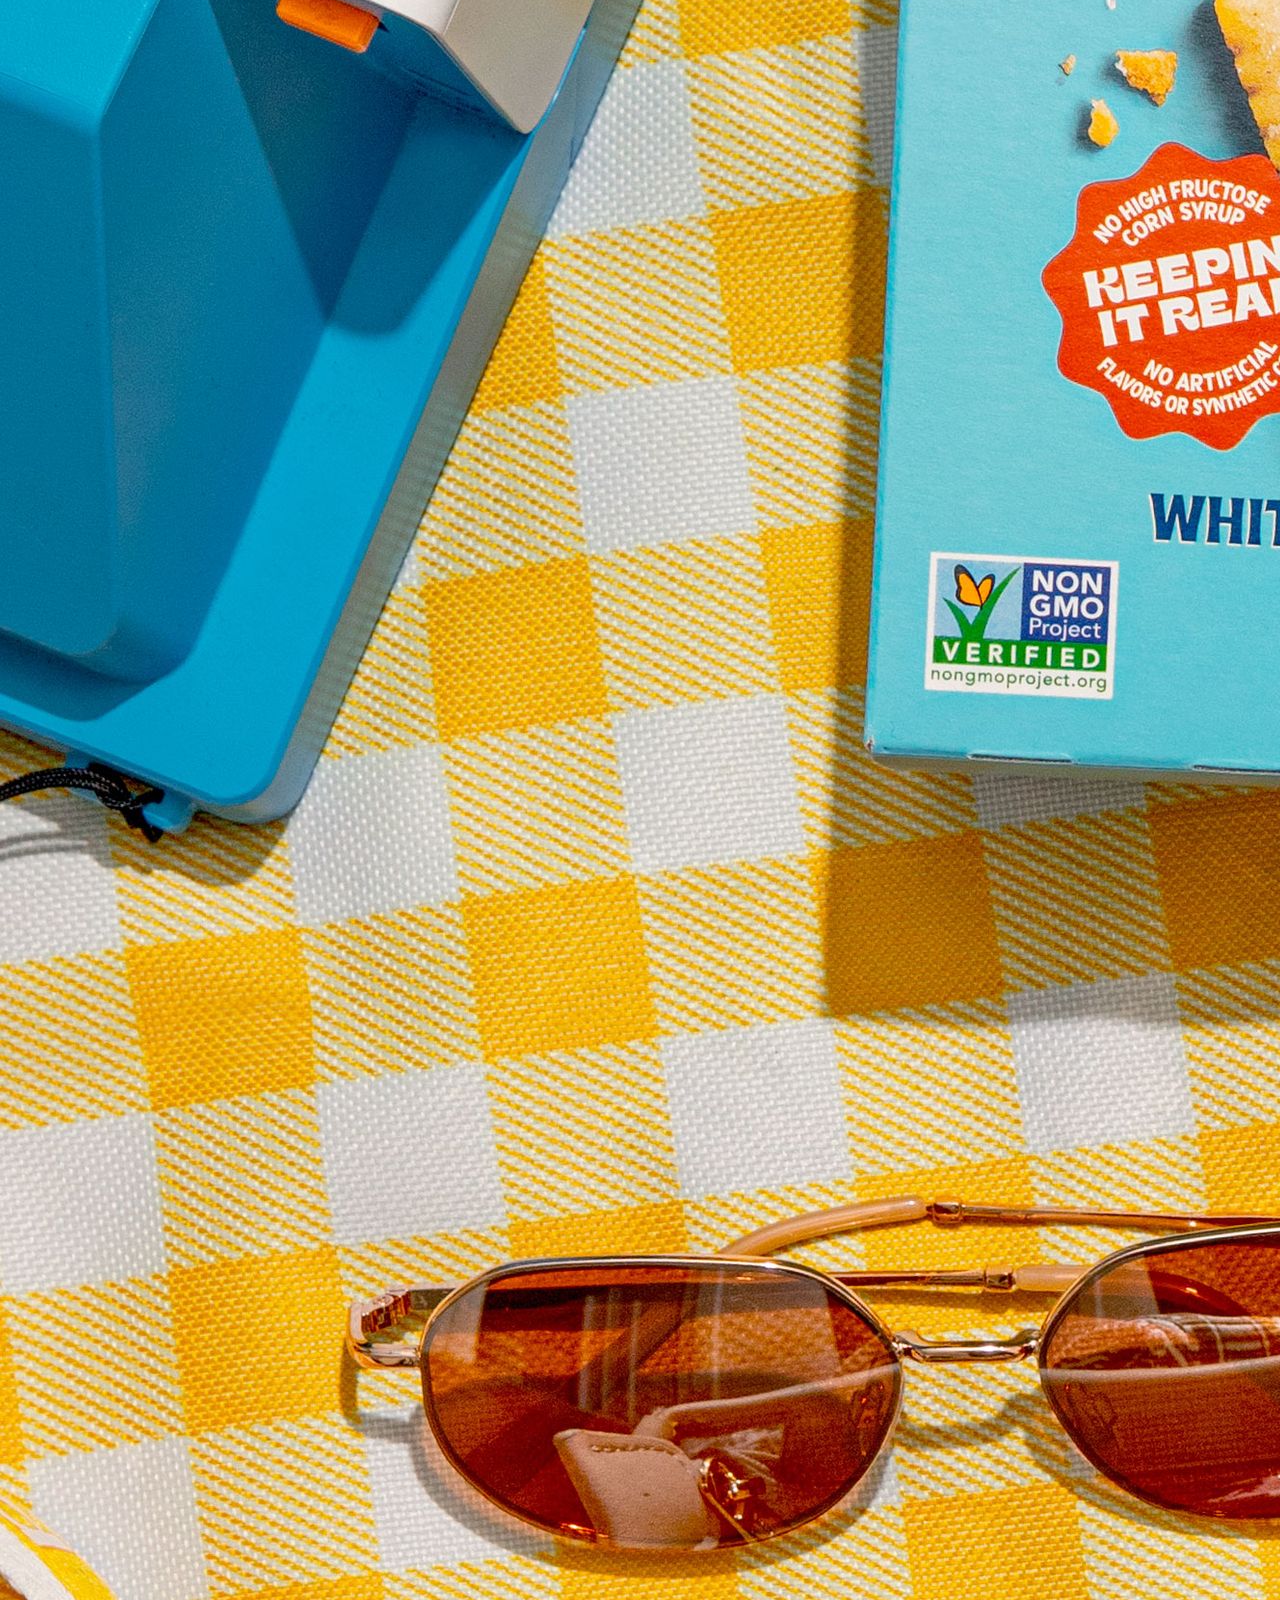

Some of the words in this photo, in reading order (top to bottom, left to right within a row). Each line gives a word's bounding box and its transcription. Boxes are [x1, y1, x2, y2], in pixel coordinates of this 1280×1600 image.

[1093, 215, 1122, 244] NO
[1118, 185, 1167, 220] HIGH
[1169, 179, 1271, 215] FRUCTOSE
[1122, 208, 1174, 247] CORN
[1180, 201, 1246, 226] SYRUP
[1097, 303, 1149, 347] IT
[1143, 359, 1174, 386] NO
[1175, 340, 1279, 392] ARTIFICIAL
[1096, 356, 1164, 408] FLAVORS
[1164, 395, 1189, 416] OR
[1192, 373, 1278, 417] SYNTHETIC
[1031, 569, 1103, 596] NON
[1029, 594, 1104, 620] GMO
[1028, 617, 1102, 642] Project
[942, 641, 1101, 669] VERIFIED
[930, 667, 1107, 693] nongmoproject.org
